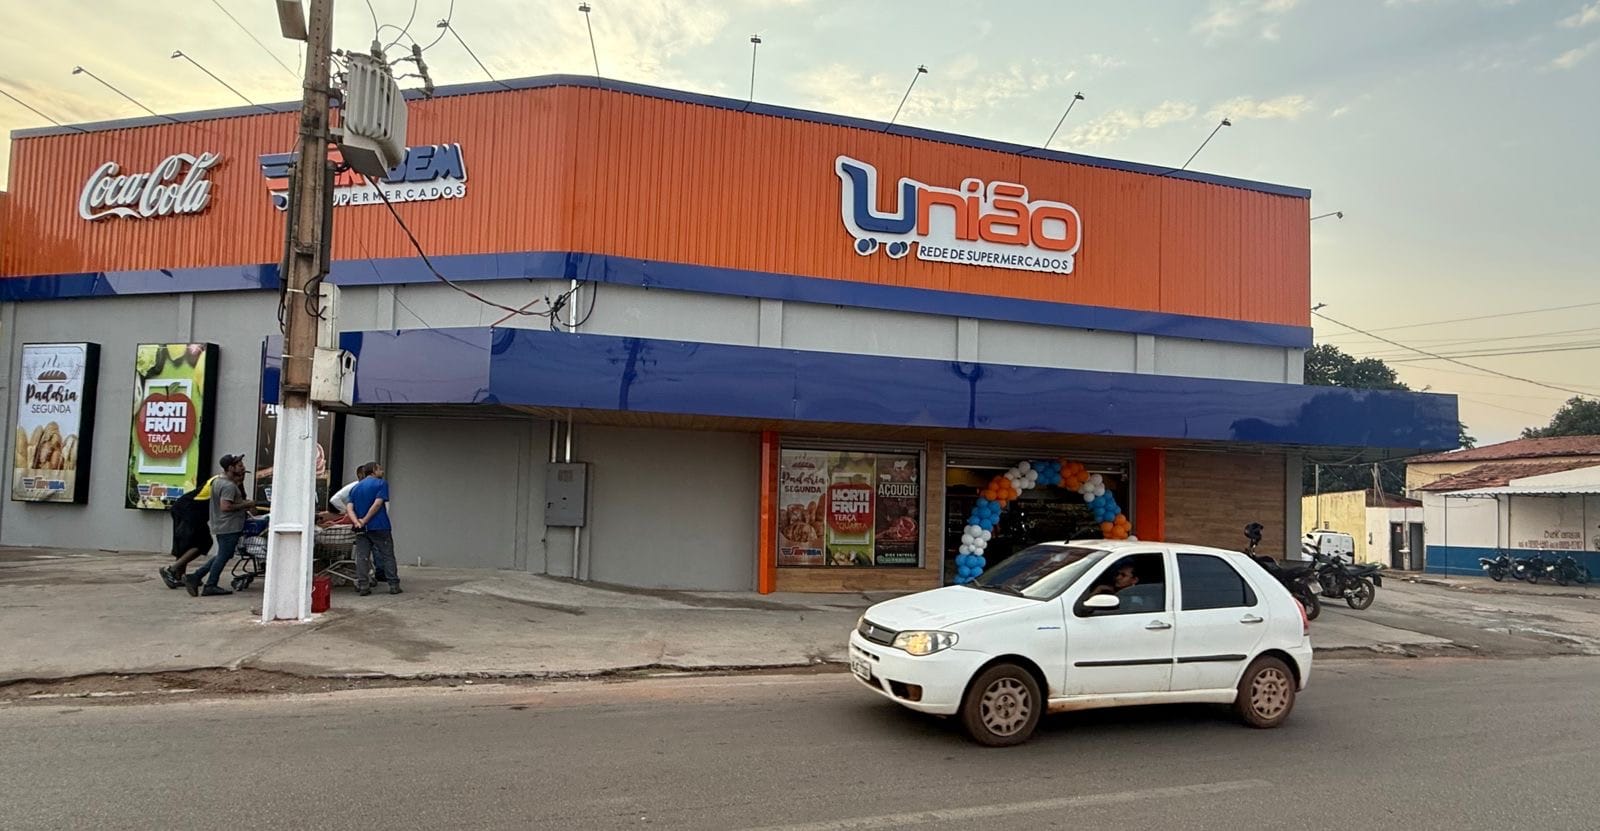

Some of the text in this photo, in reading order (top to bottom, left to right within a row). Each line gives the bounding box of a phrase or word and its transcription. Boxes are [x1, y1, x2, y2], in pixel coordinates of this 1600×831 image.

[79, 152, 222, 220] Coca-Cola
[333, 185, 463, 203] UPERMERCADOS
[919, 245, 1069, 271] REDE DE SUPERMERCADOS
[25, 383, 78, 404] Padaria
[31, 403, 72, 414] SEGUNDA
[145, 401, 187, 417] HORTI
[144, 417, 187, 433] FRUTI
[147, 433, 171, 445] TERÇA
[152, 444, 183, 454] QUARTA
[781, 471, 825, 485] Padaria
[784, 485, 822, 494] SEGUNDA
[831, 489, 869, 502] HORTI
[831, 501, 870, 514] FRUTI
[834, 514, 857, 522] TERÇA
